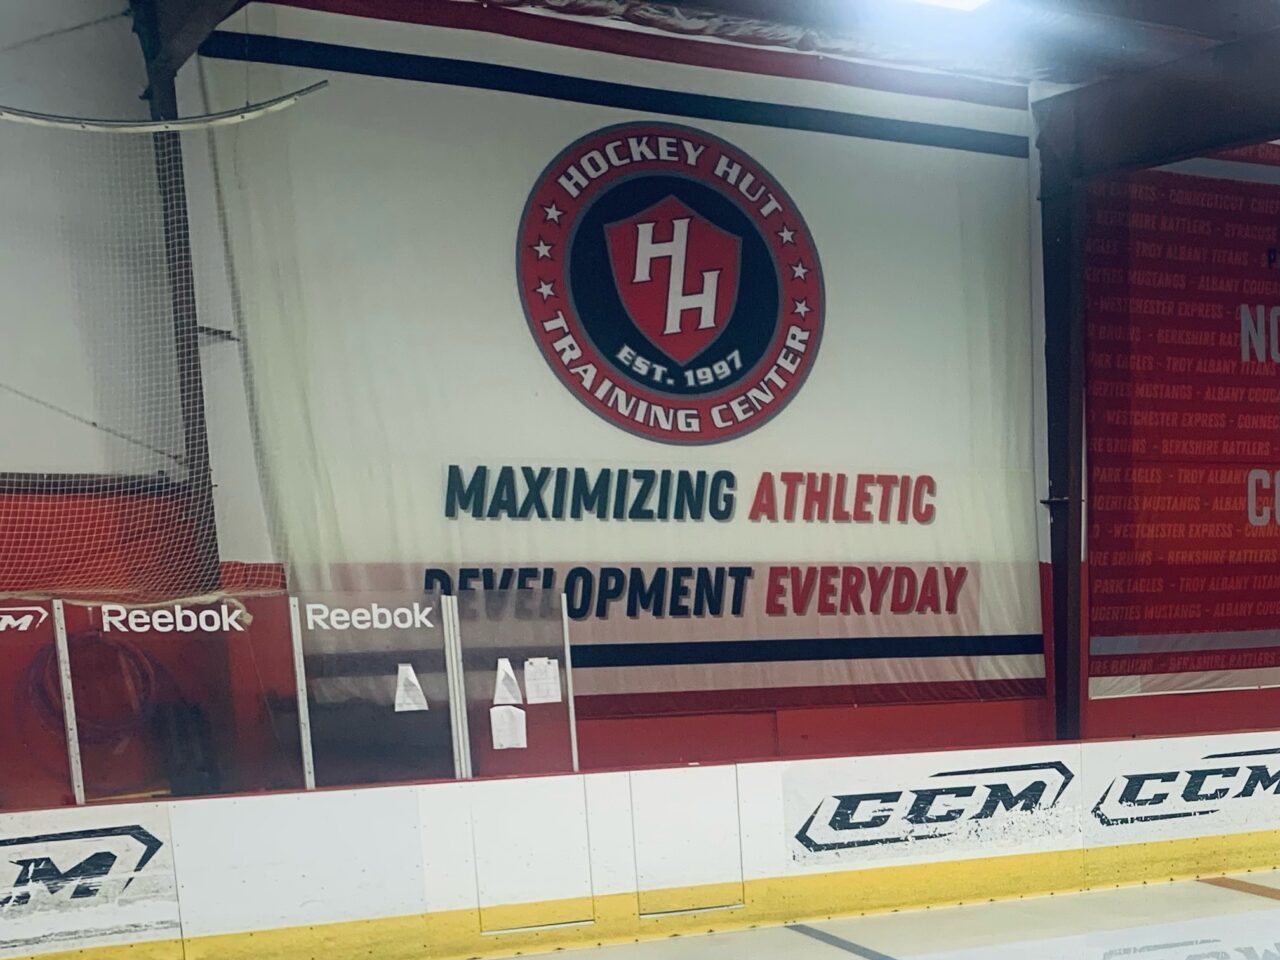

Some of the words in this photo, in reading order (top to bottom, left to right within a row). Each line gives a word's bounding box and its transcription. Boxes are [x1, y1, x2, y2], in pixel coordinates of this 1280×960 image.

[558, 135, 704, 198] HOCKEY
[714, 154, 783, 219] HUT
[542, 310, 700, 433] TRAINING
[711, 325, 811, 430] CENTER
[616, 346, 674, 386] EST.
[685, 350, 743, 387] 1997
[444, 464, 738, 521] MAXIMIZING
[748, 471, 937, 525] ATHLETIC
[101, 604, 245, 632] Reebok
[306, 602, 434, 630] Reebok
[424, 566, 753, 620] DEVELOPMENT
[766, 565, 968, 616] EVERYDAY
[818, 775, 1054, 836] CCM
